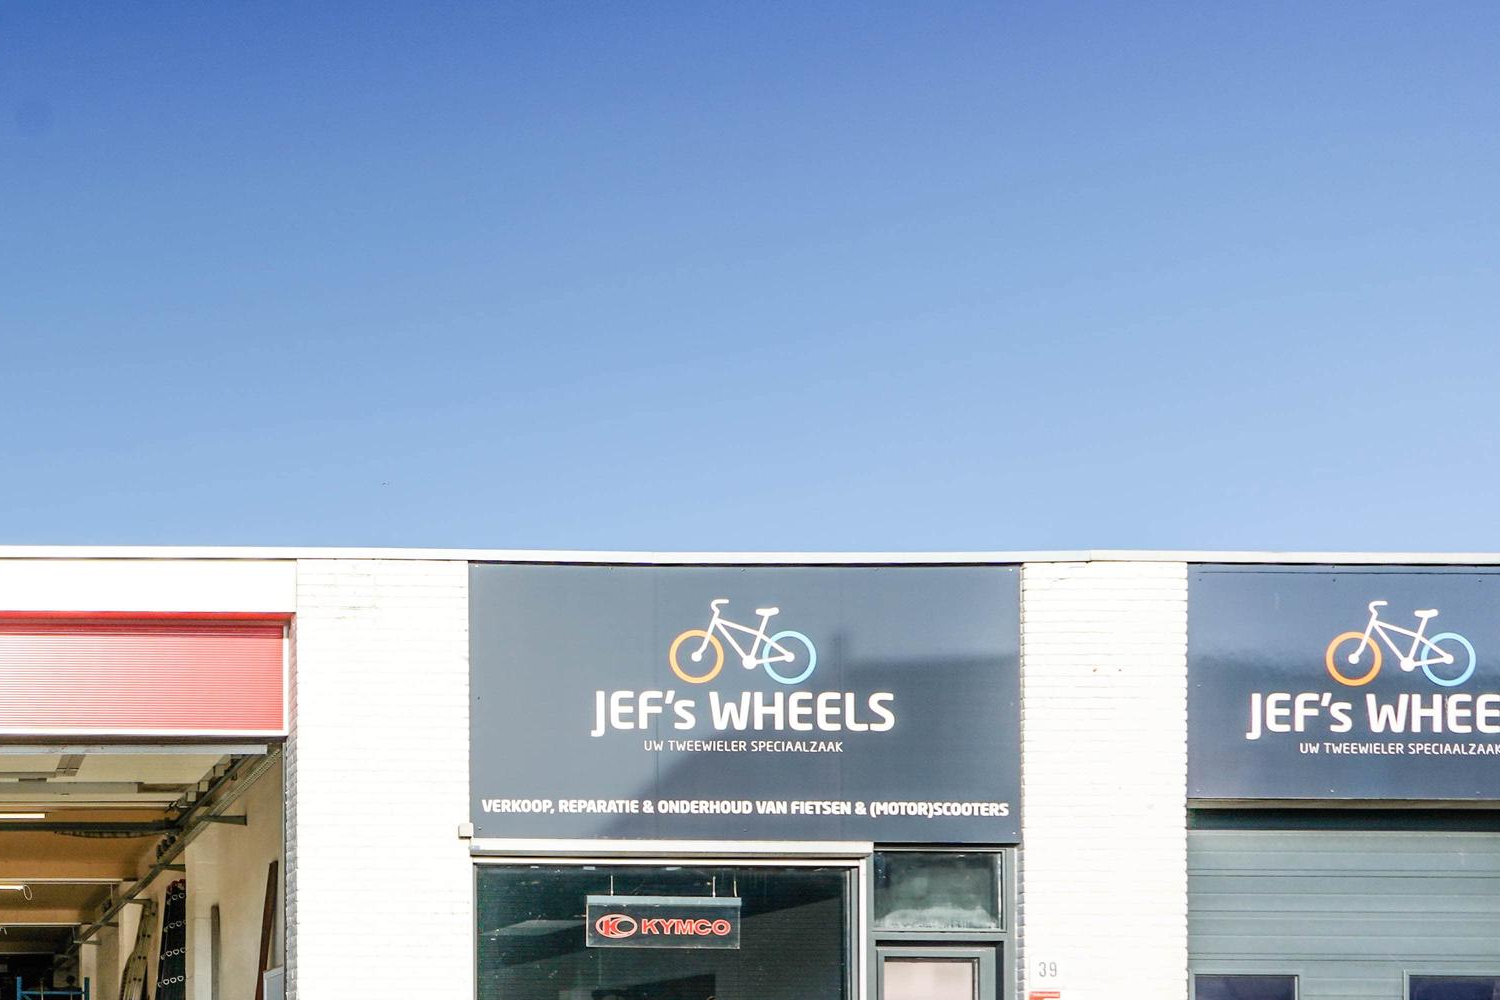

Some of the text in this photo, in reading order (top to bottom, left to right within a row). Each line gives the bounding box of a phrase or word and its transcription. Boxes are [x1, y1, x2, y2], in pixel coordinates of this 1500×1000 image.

[591, 690, 896, 738] JEF's WHEELS
[1245, 692, 1353, 740] JEF's
[644, 740, 844, 753] UW TWEEWIELER SPECIAALZAAK
[1299, 742, 1320, 755] UW
[1324, 742, 1404, 755] TWEEWIELER
[481, 799, 1009, 819] VERKOOP, REPARATIE & ONDERHOUD VAN FIETSEN & (MOTOR)SCOOTERS
[641, 918, 731, 936] KYMCO
[1038, 961, 1058, 978] 39
